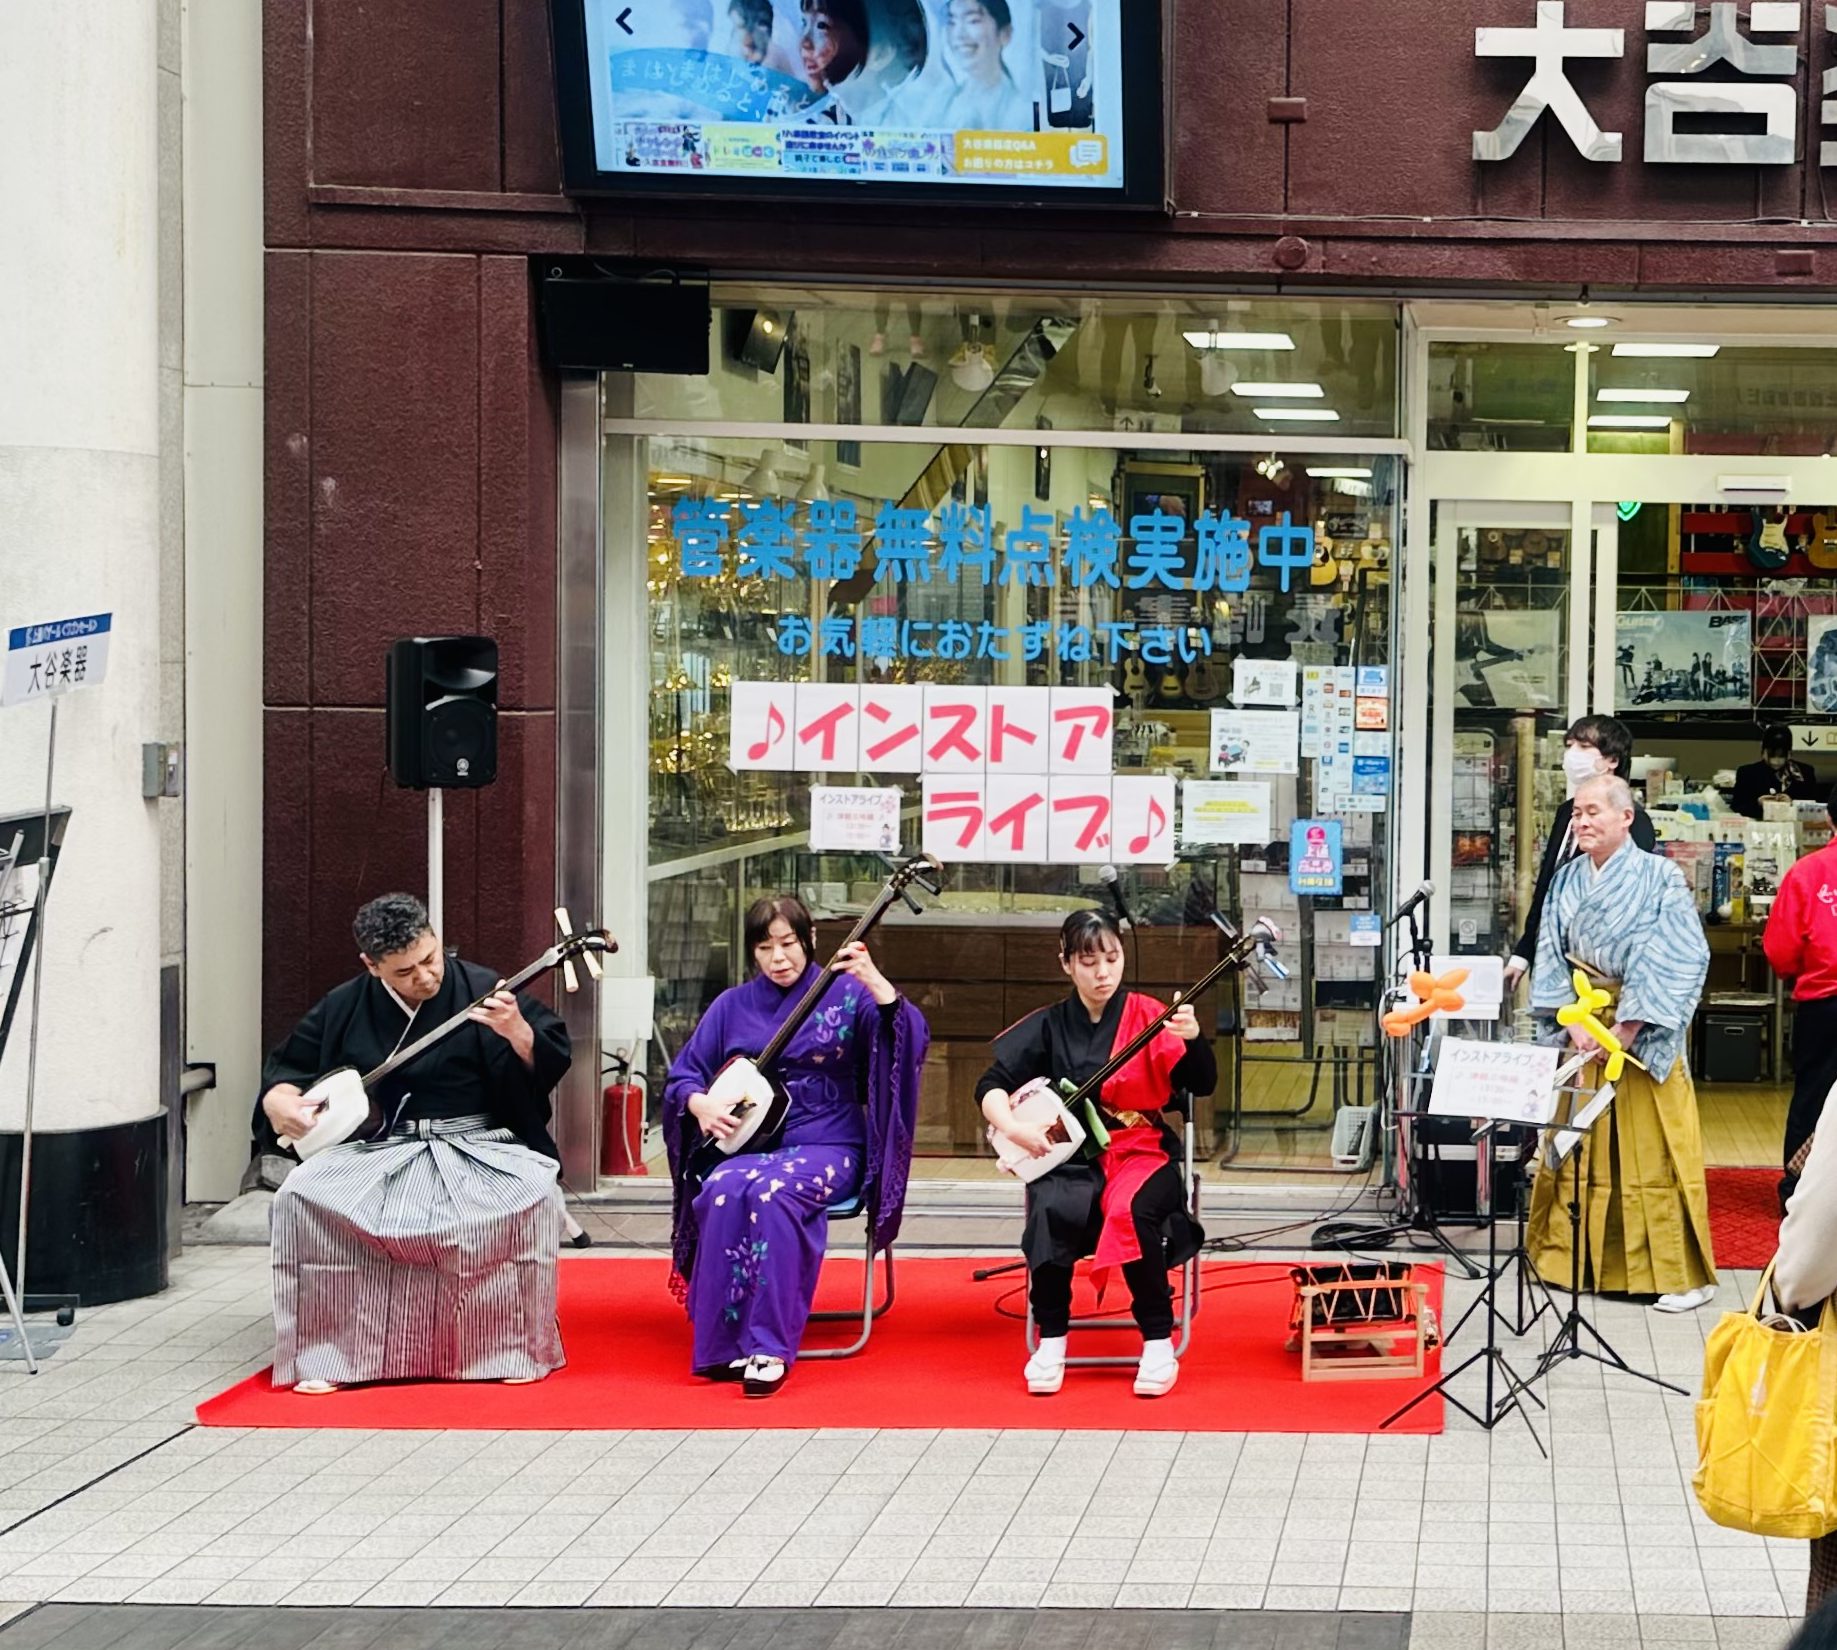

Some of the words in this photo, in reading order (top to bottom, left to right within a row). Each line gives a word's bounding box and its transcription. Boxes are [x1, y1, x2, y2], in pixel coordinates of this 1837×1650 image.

[1472, 1, 1837, 166] 大谷
[673, 496, 1315, 592] 管楽器無料点検実施中
[779, 616, 1210, 663] お気軽におたずね下さい
[28, 645, 88, 694] 大谷楽器
[800, 703, 1109, 762] インストア
[820, 794, 882, 805] インストアライブ
[928, 792, 1109, 850] ライブ
[1451, 1049, 1533, 1065] インストアライブ
